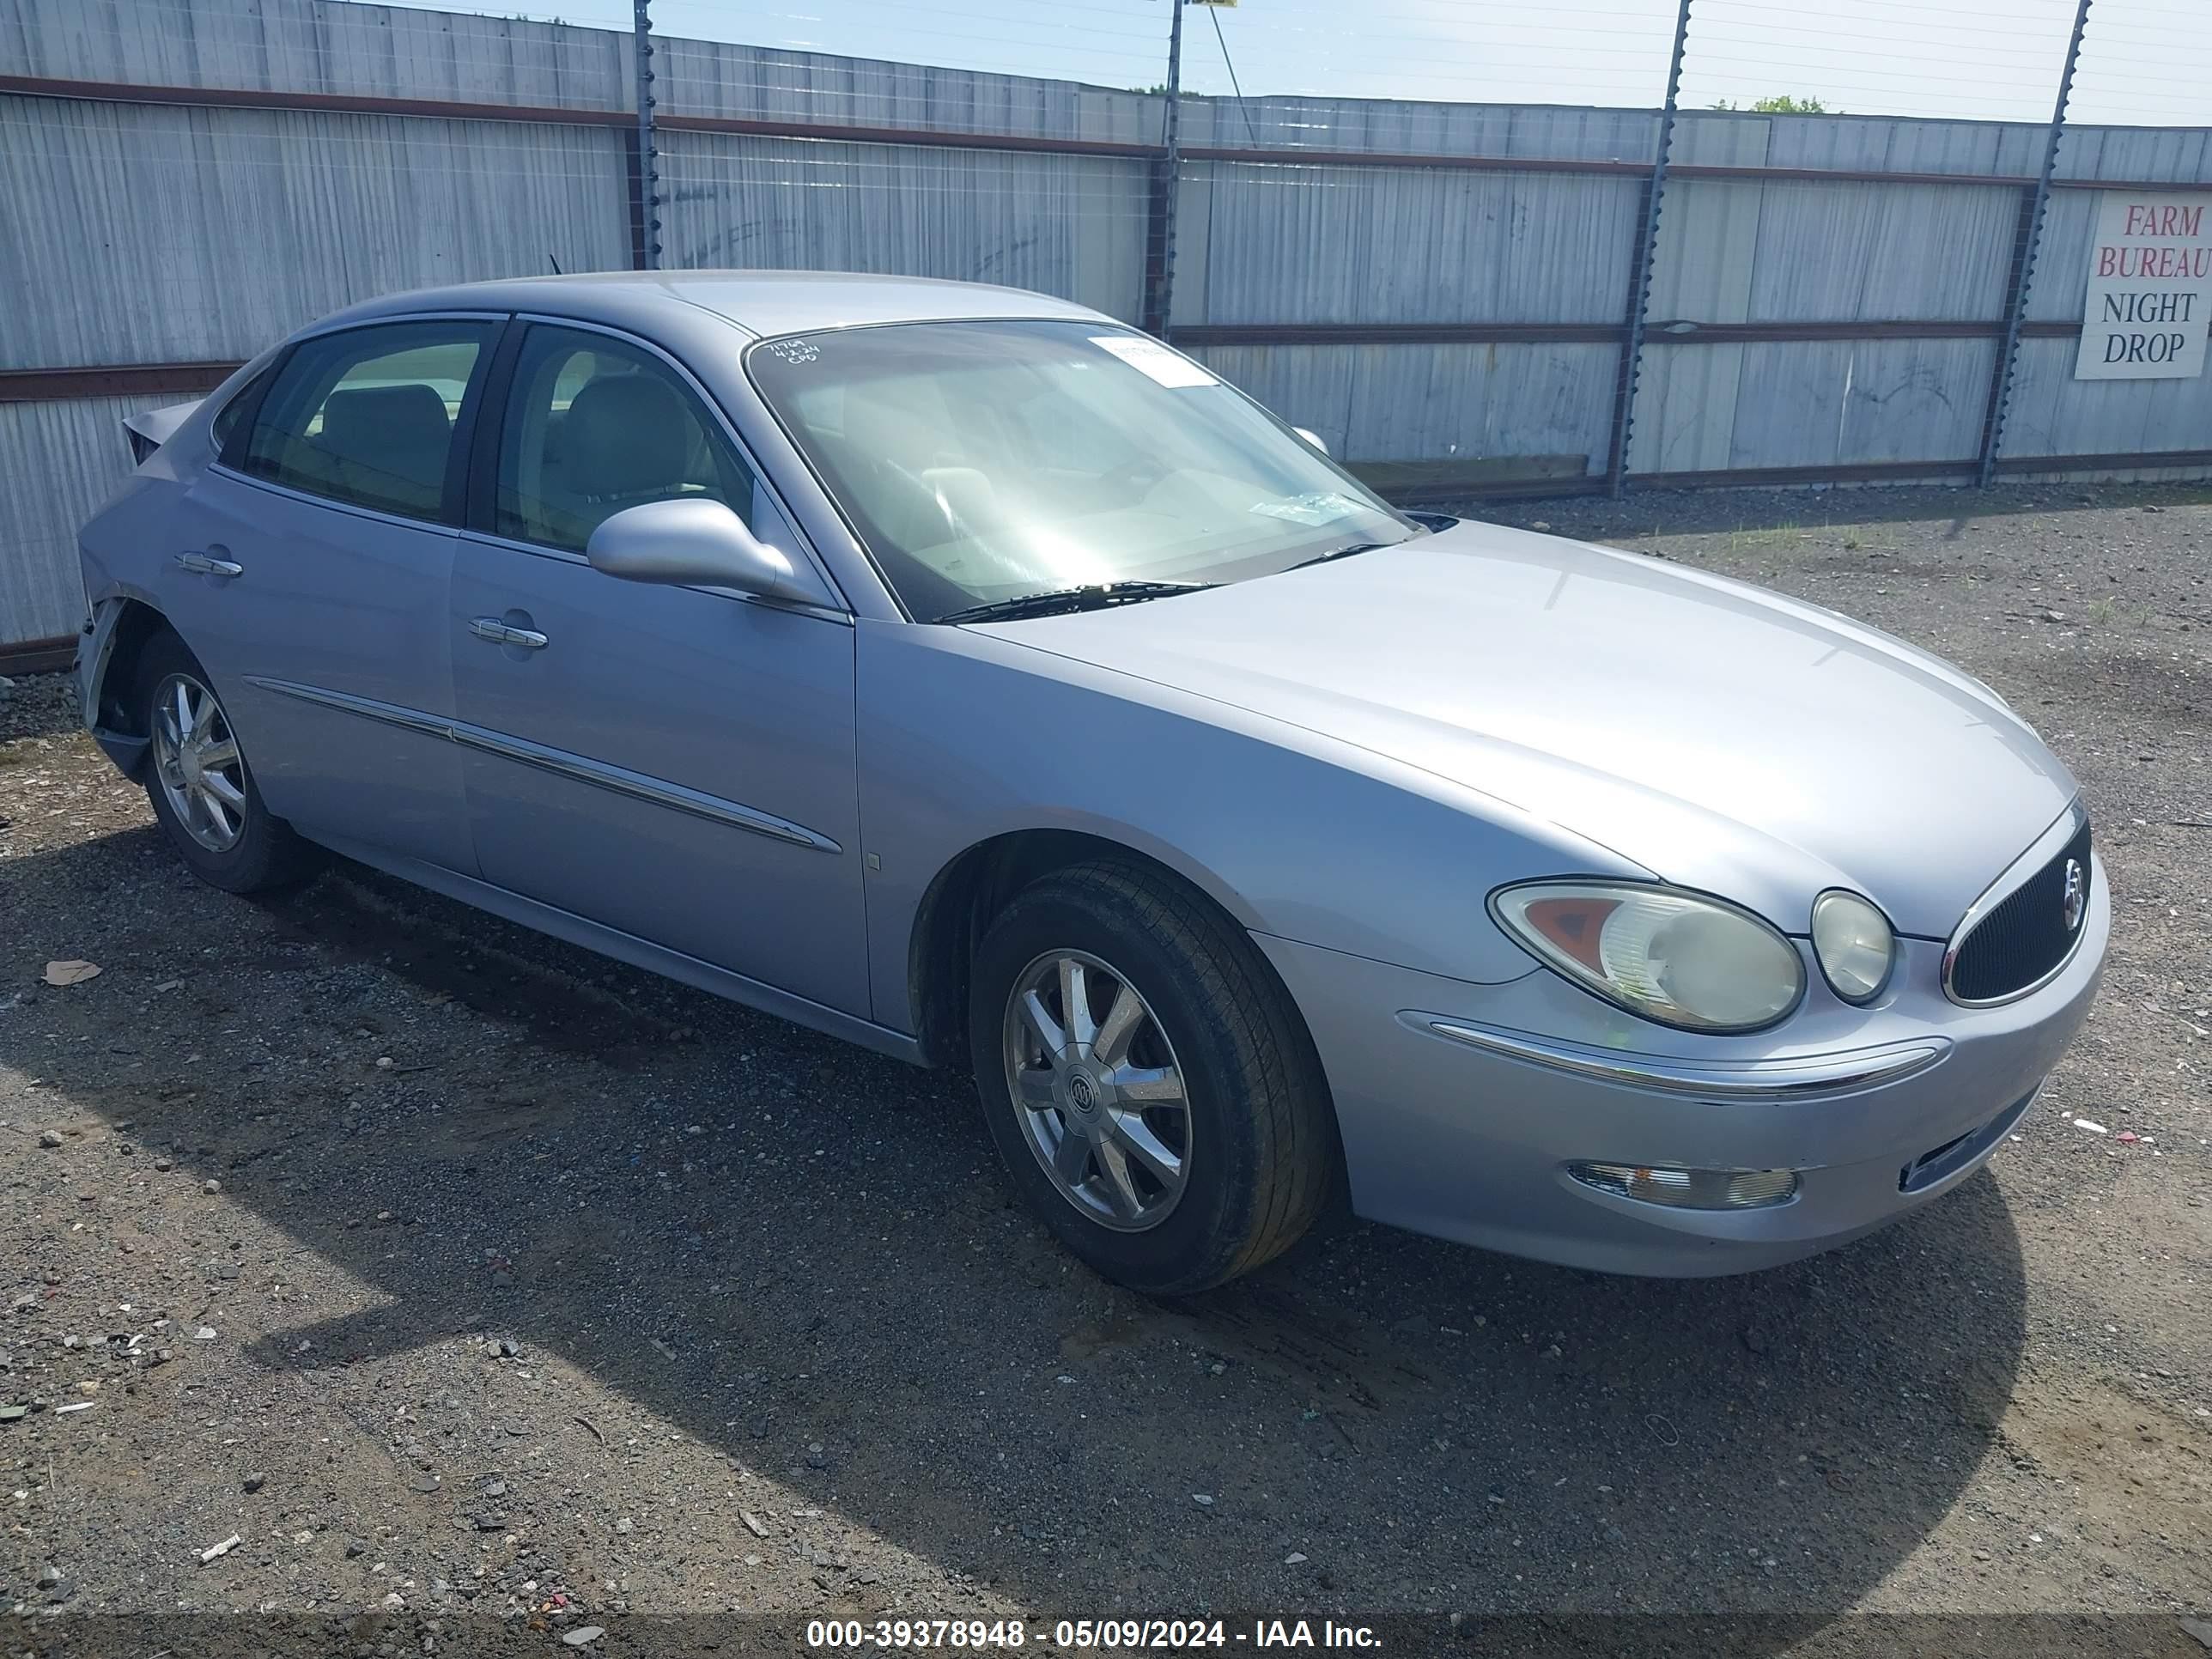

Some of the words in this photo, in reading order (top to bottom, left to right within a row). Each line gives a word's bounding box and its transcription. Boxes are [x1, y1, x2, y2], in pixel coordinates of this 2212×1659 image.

[2124, 204, 2205, 236] FARM
[2097, 246, 2212, 278] BUREAU
[2102, 292, 2198, 323] NIGHT
[2103, 332, 2185, 363] DROP
